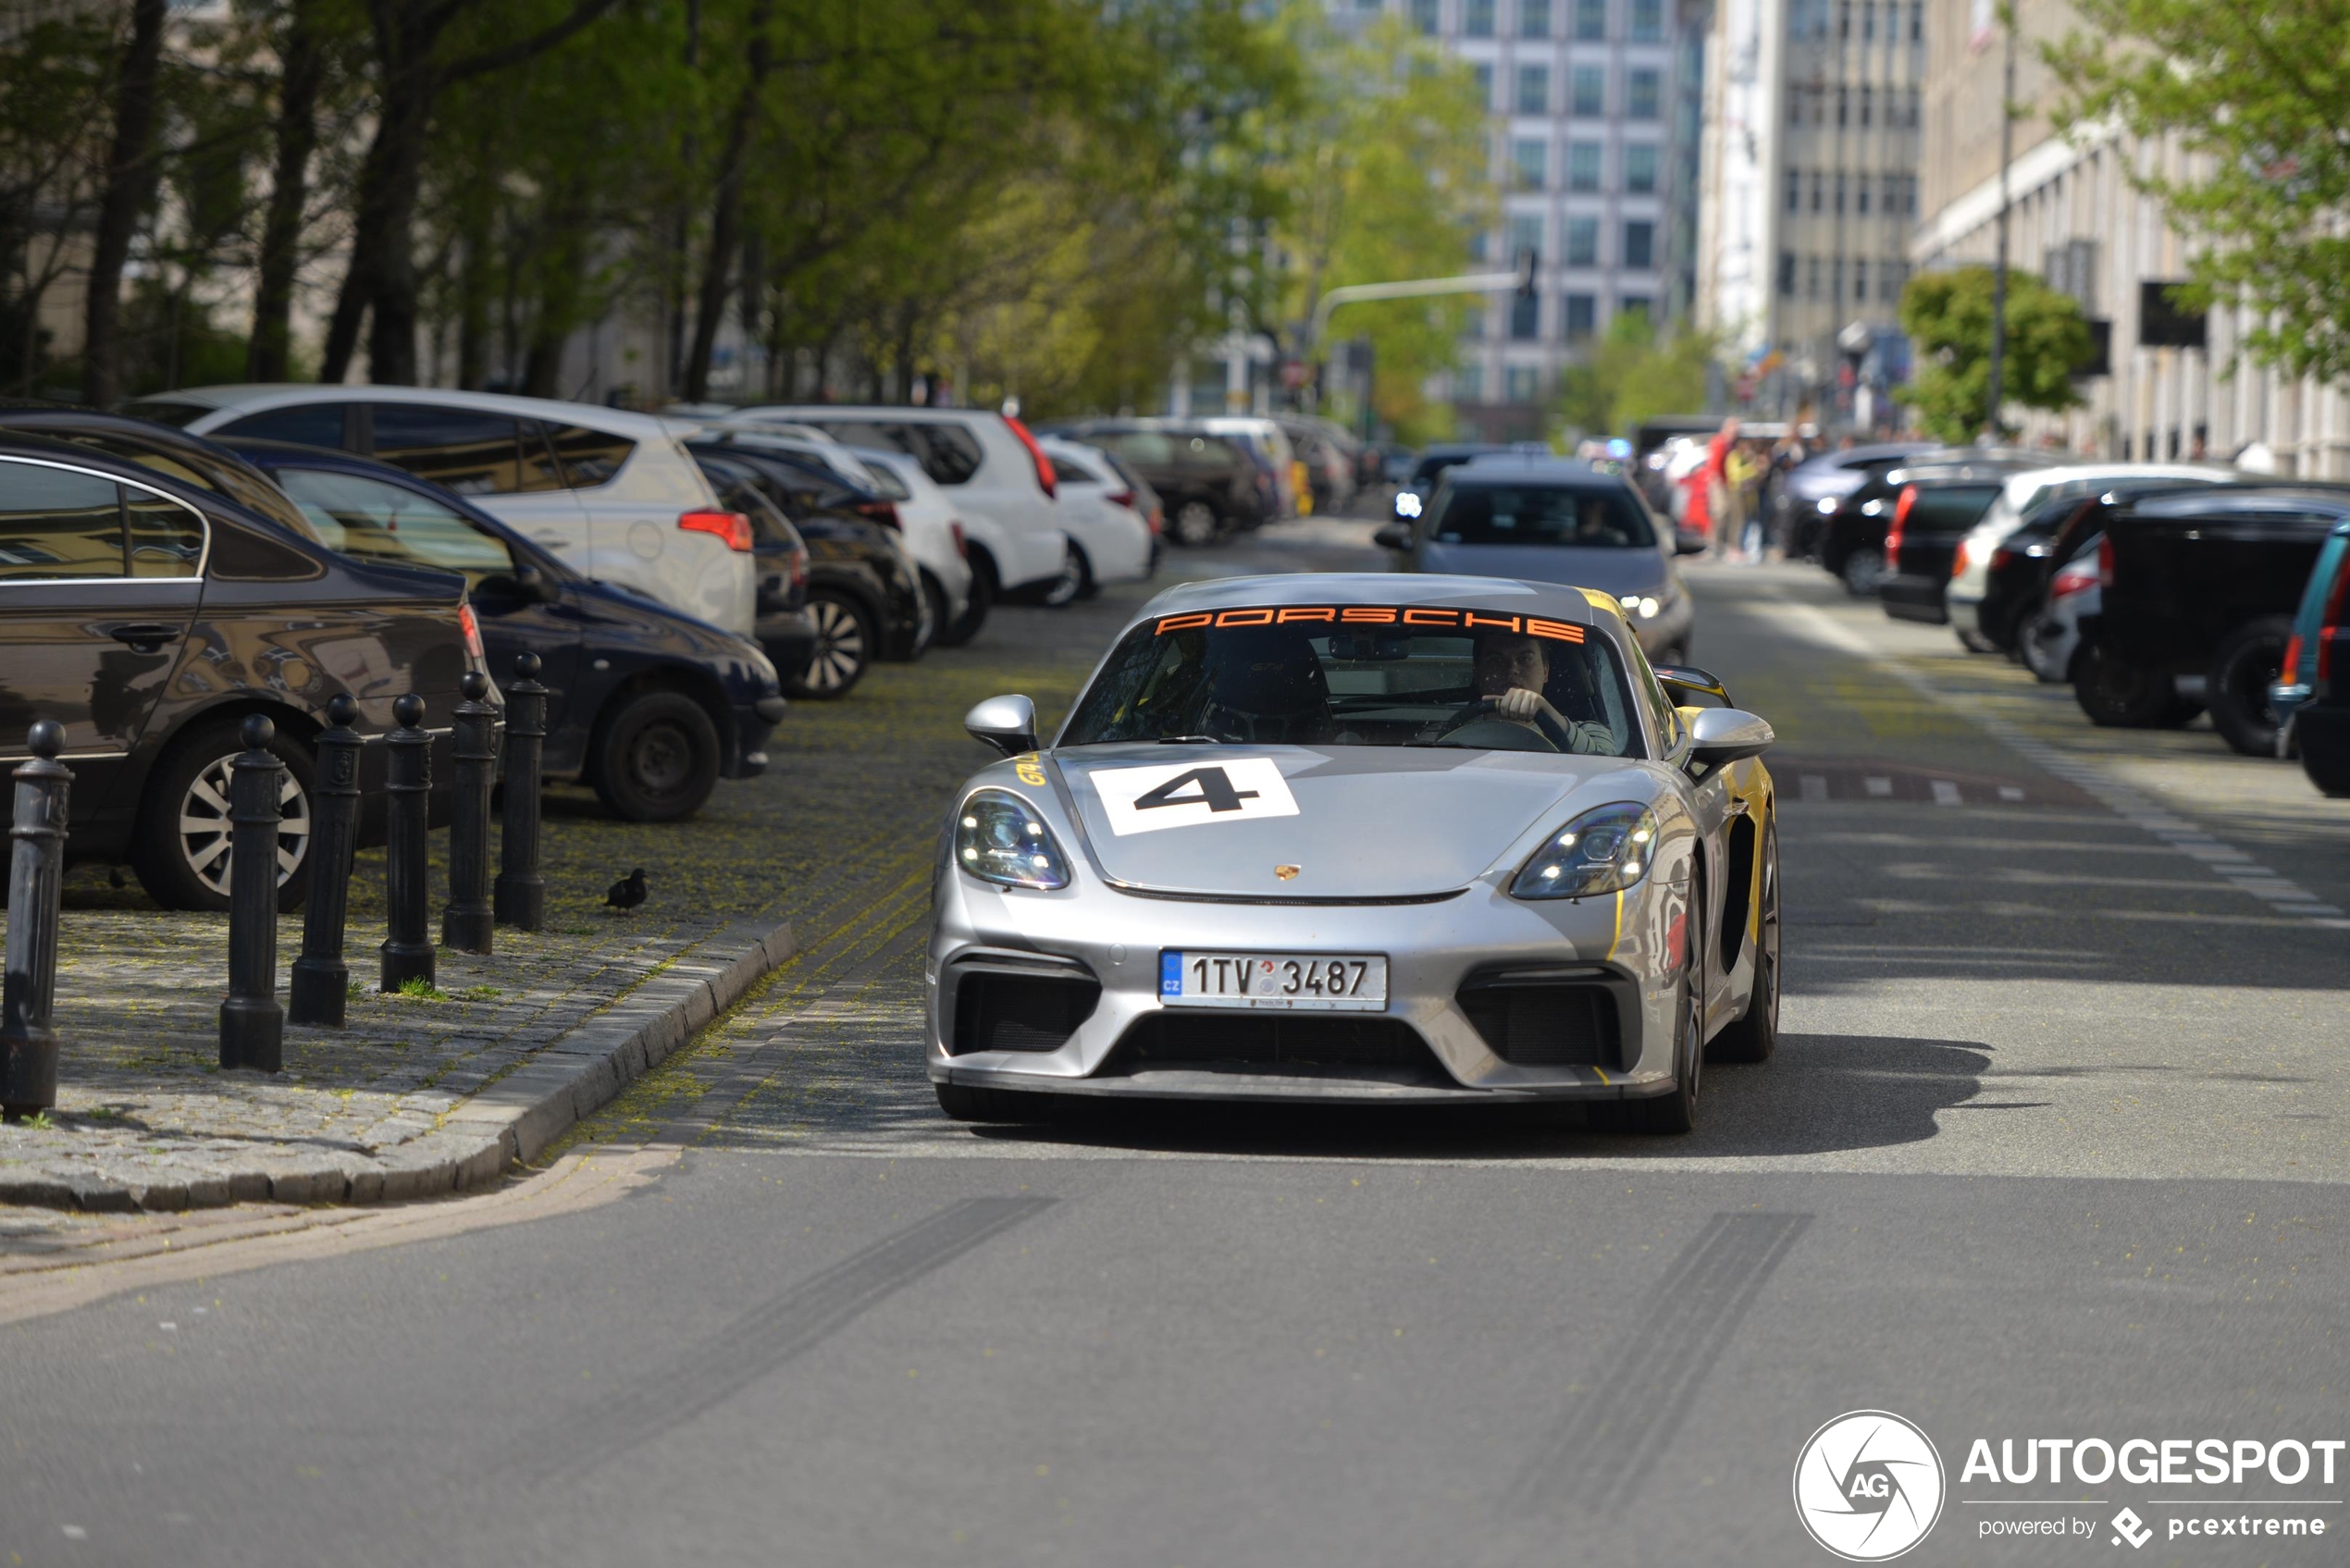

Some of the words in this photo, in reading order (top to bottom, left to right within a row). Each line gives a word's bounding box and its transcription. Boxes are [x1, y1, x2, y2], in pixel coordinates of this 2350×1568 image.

[1155, 607, 1585, 645] PORSCHE
[1133, 767, 1260, 812] 4
[1163, 980, 1180, 992] CZ
[1193, 957, 1253, 994] 1TV
[1282, 960, 1367, 995] 3487
